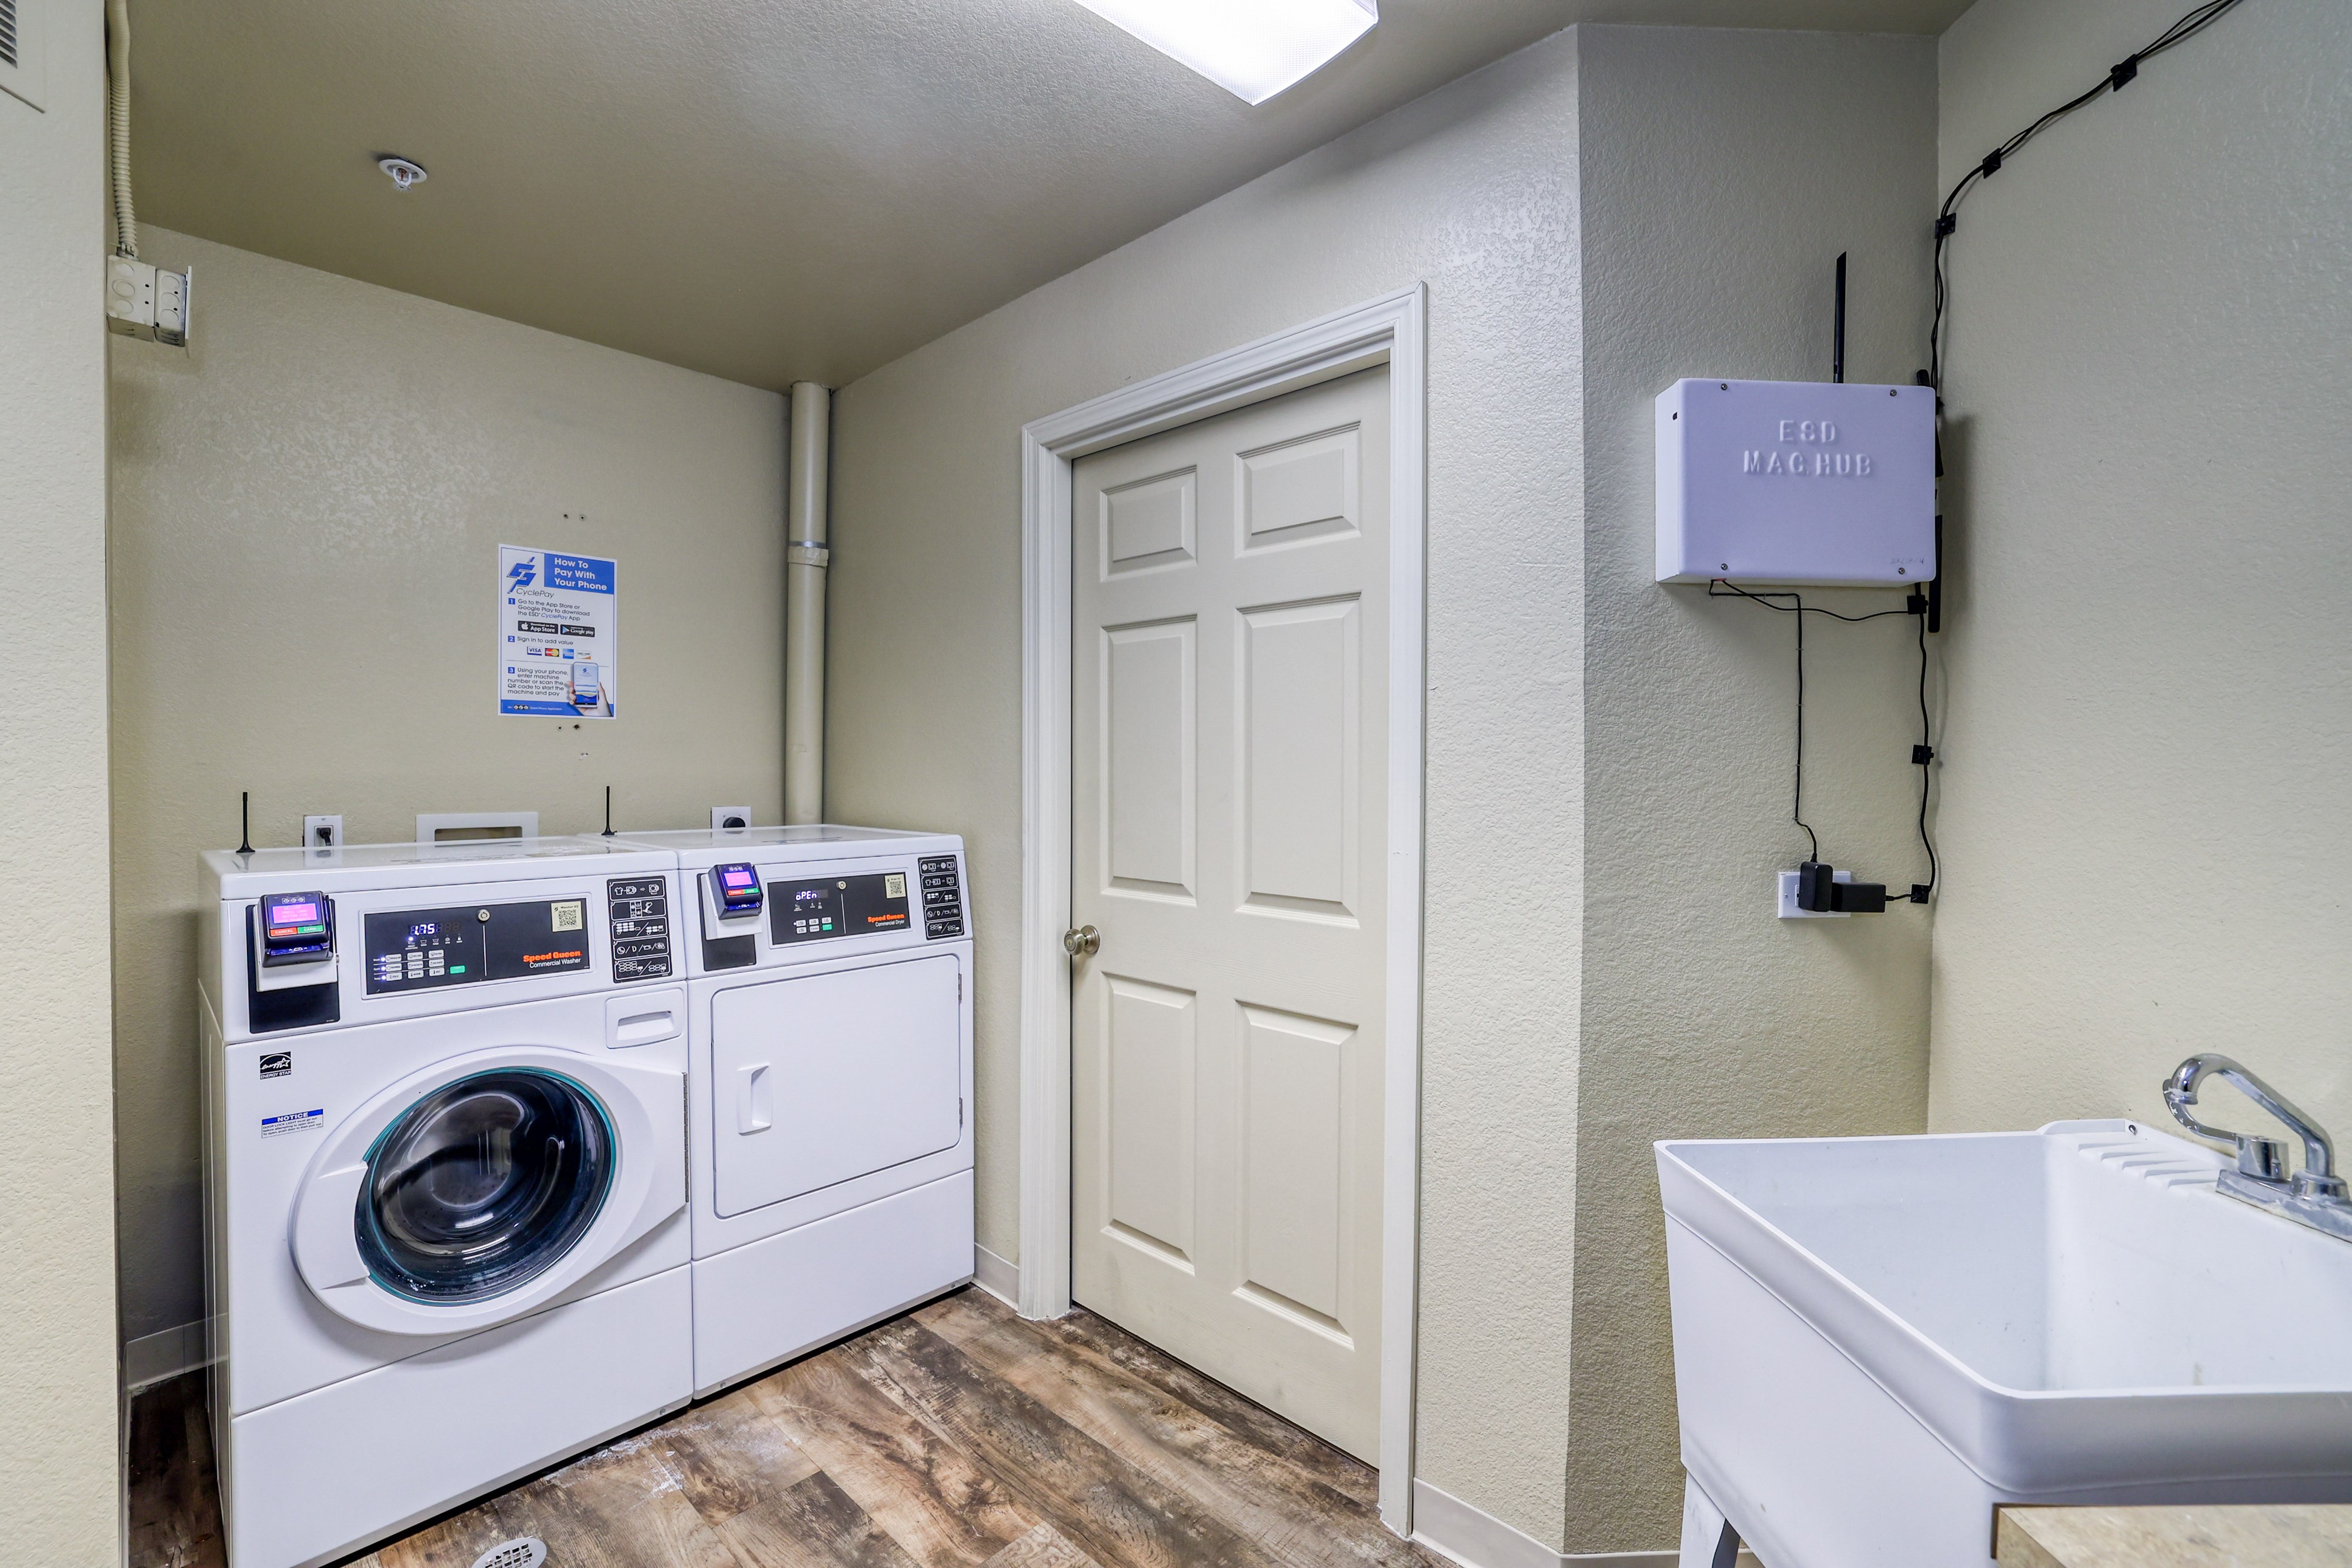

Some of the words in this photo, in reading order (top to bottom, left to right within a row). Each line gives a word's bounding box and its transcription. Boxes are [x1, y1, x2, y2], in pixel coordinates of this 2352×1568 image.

[1743, 450, 1805, 474] MAC
[1816, 453, 1872, 476] HUB
[554, 557, 575, 567] How
[554, 568, 572, 578] Pay
[575, 570, 595, 579] With
[554, 578, 575, 587] Your
[578, 581, 607, 590] Phone
[516, 588, 554, 599] CyclePay
[523, 952, 552, 962] Speed
[278, 1112, 309, 1122] NOTICE
